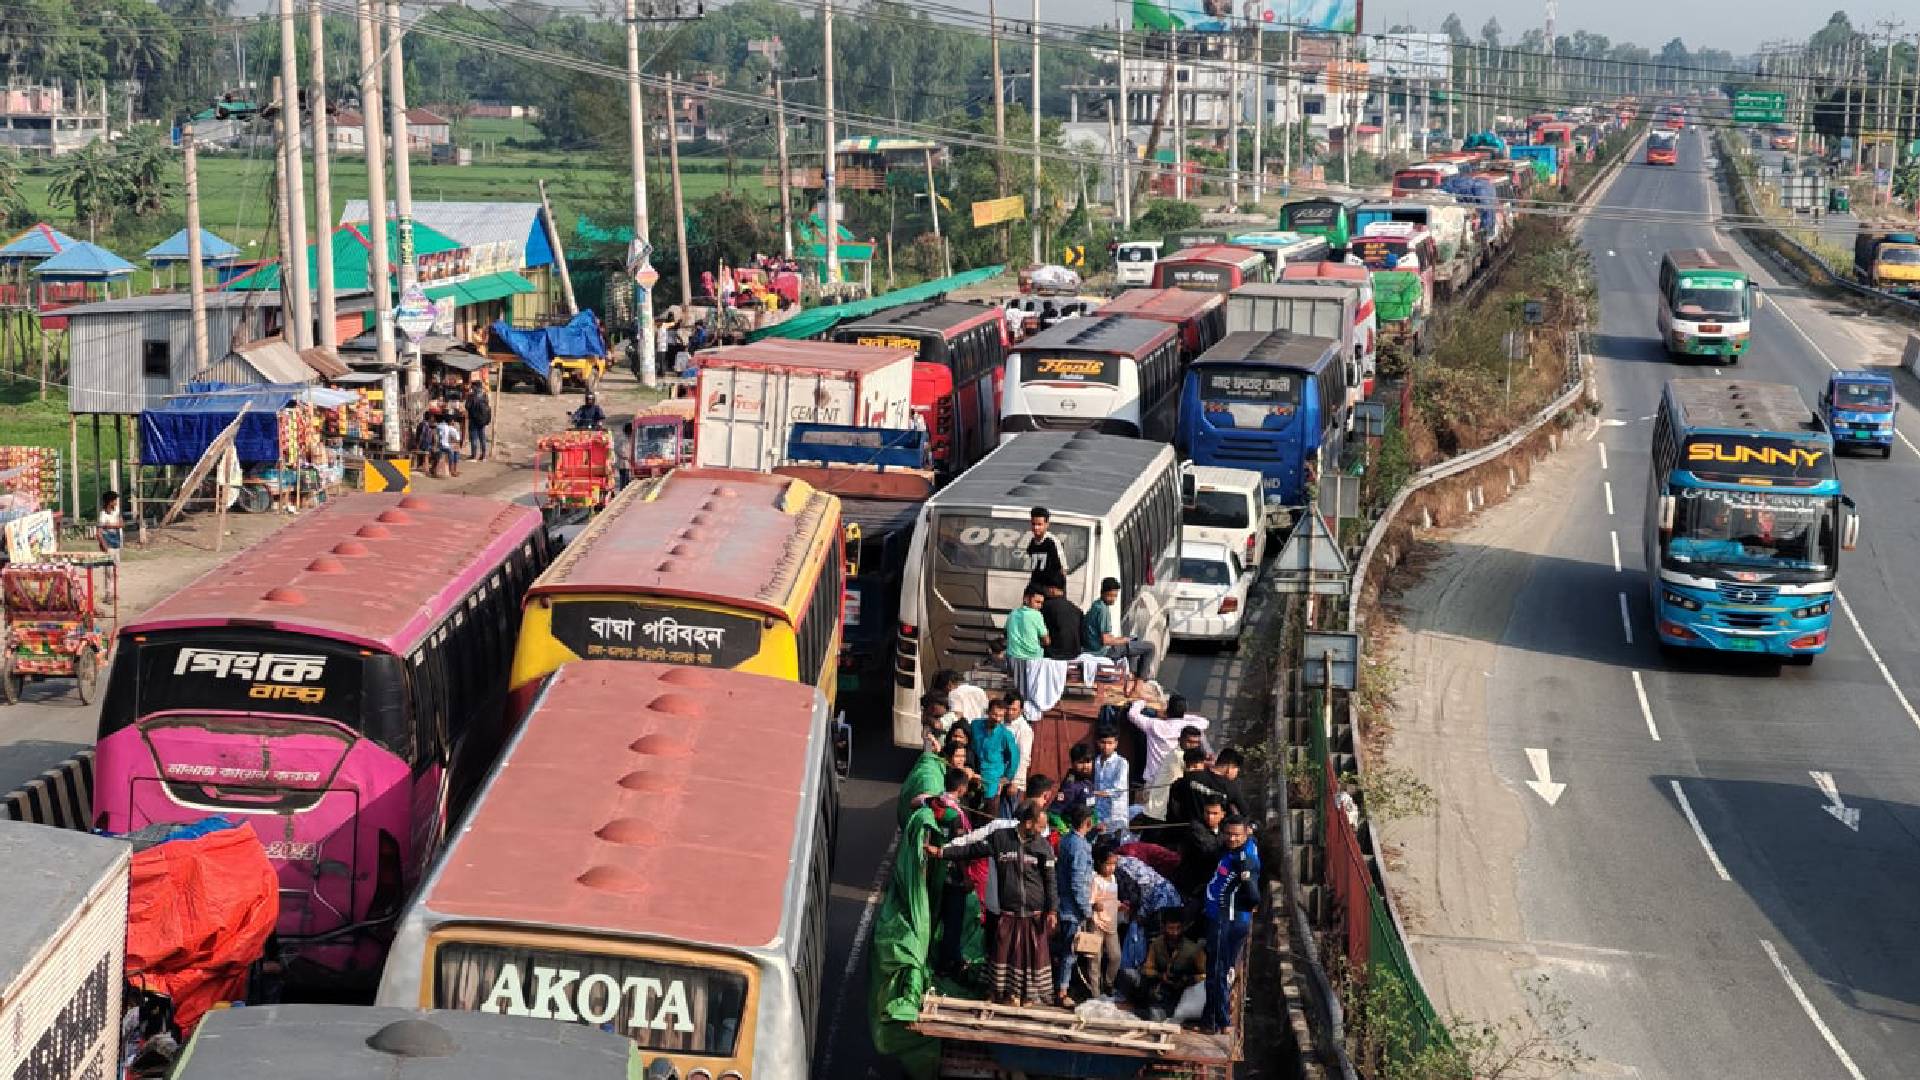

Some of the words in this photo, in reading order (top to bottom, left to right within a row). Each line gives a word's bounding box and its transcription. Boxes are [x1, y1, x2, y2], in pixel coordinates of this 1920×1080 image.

[790, 405, 840, 422] CEMNT
[1688, 442, 1824, 467] SUNNY
[588, 616, 636, 641] বাঘা
[642, 616, 726, 650] পরিবহন
[480, 963, 695, 1032] AKOTA
